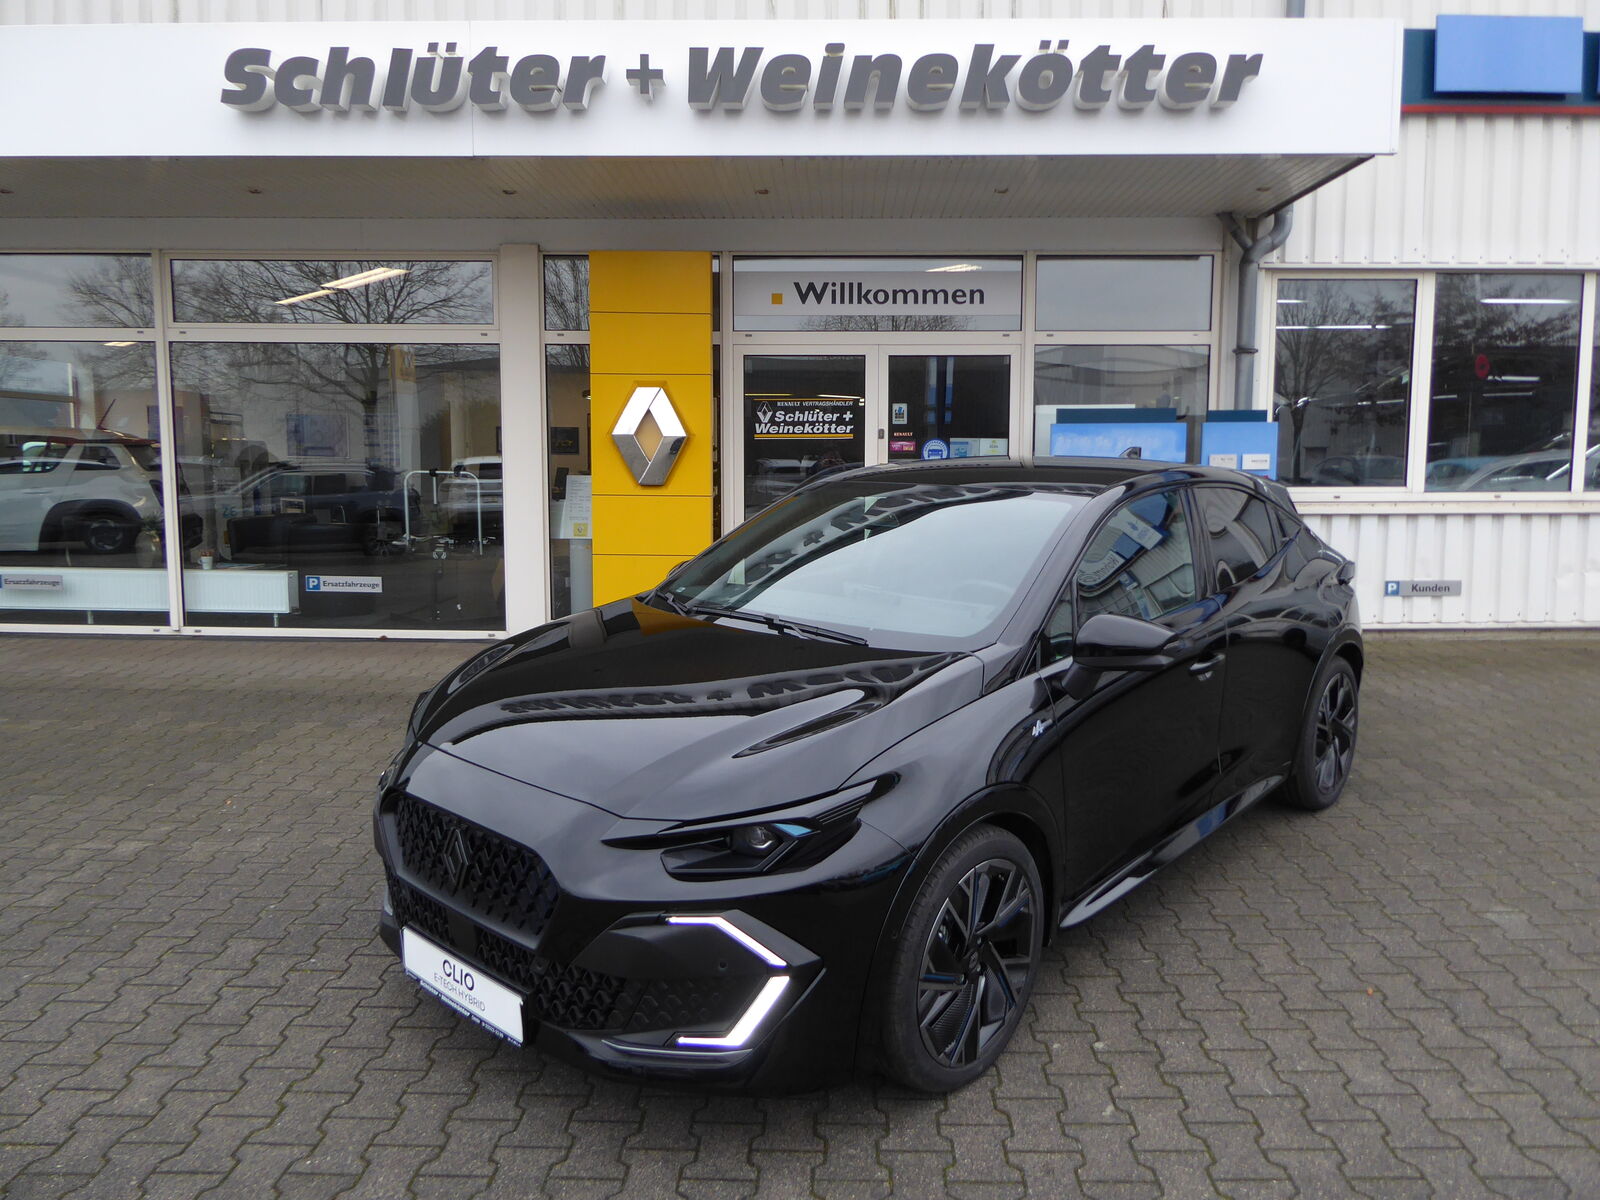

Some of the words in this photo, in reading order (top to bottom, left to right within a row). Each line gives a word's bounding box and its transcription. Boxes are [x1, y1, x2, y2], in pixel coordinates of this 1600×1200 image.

[220, 42, 606, 111] Schlüter
[626, 54, 667, 100] +
[688, 40, 1263, 111] Weinekötter
[793, 281, 985, 305] Willkommen
[774, 410, 840, 422] Schlüter
[843, 410, 853, 422] +
[755, 423, 854, 434] Weinekötter
[4, 578, 60, 586] Ersatzfahrzeuge
[309, 578, 318, 589] P
[322, 580, 380, 588] Ersatzfahrzeuge
[1388, 583, 1397, 594] P
[1411, 583, 1450, 593] Kunden
[442, 959, 475, 992] CLIO
[434, 973, 458, 994] E-TECH
[458, 985, 486, 1012] HYBRID
